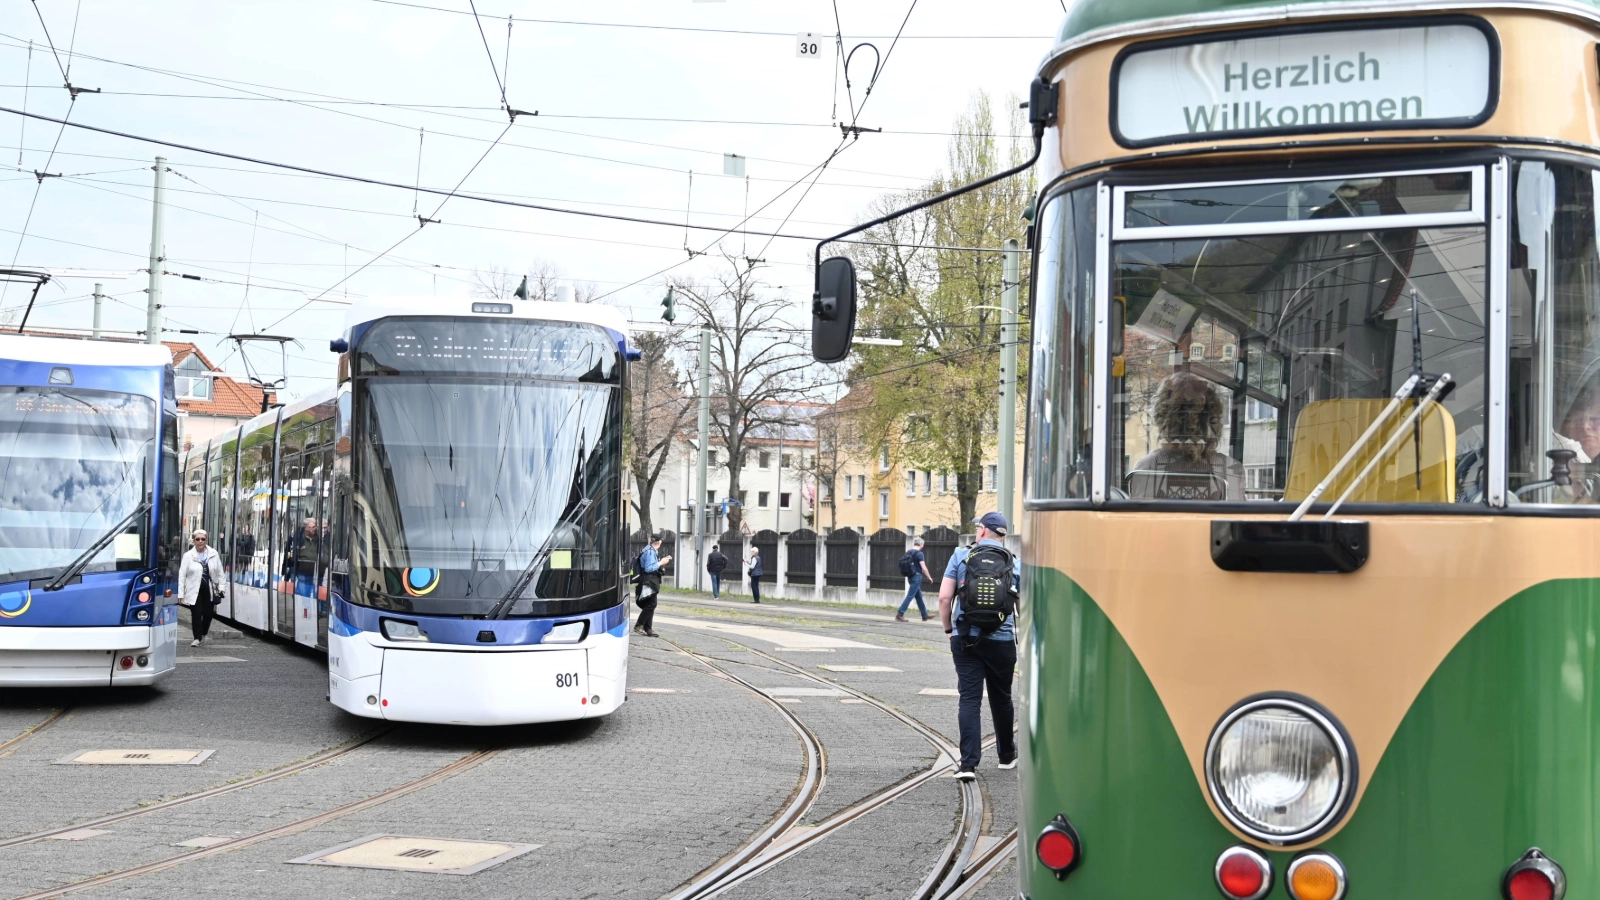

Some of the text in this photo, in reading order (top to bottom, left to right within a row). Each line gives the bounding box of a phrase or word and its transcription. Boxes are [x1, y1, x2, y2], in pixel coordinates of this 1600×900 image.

[801, 42, 817, 54] 30
[1224, 51, 1380, 92] Herzlich
[1183, 94, 1423, 133] Willkommen
[556, 672, 579, 688] 801
